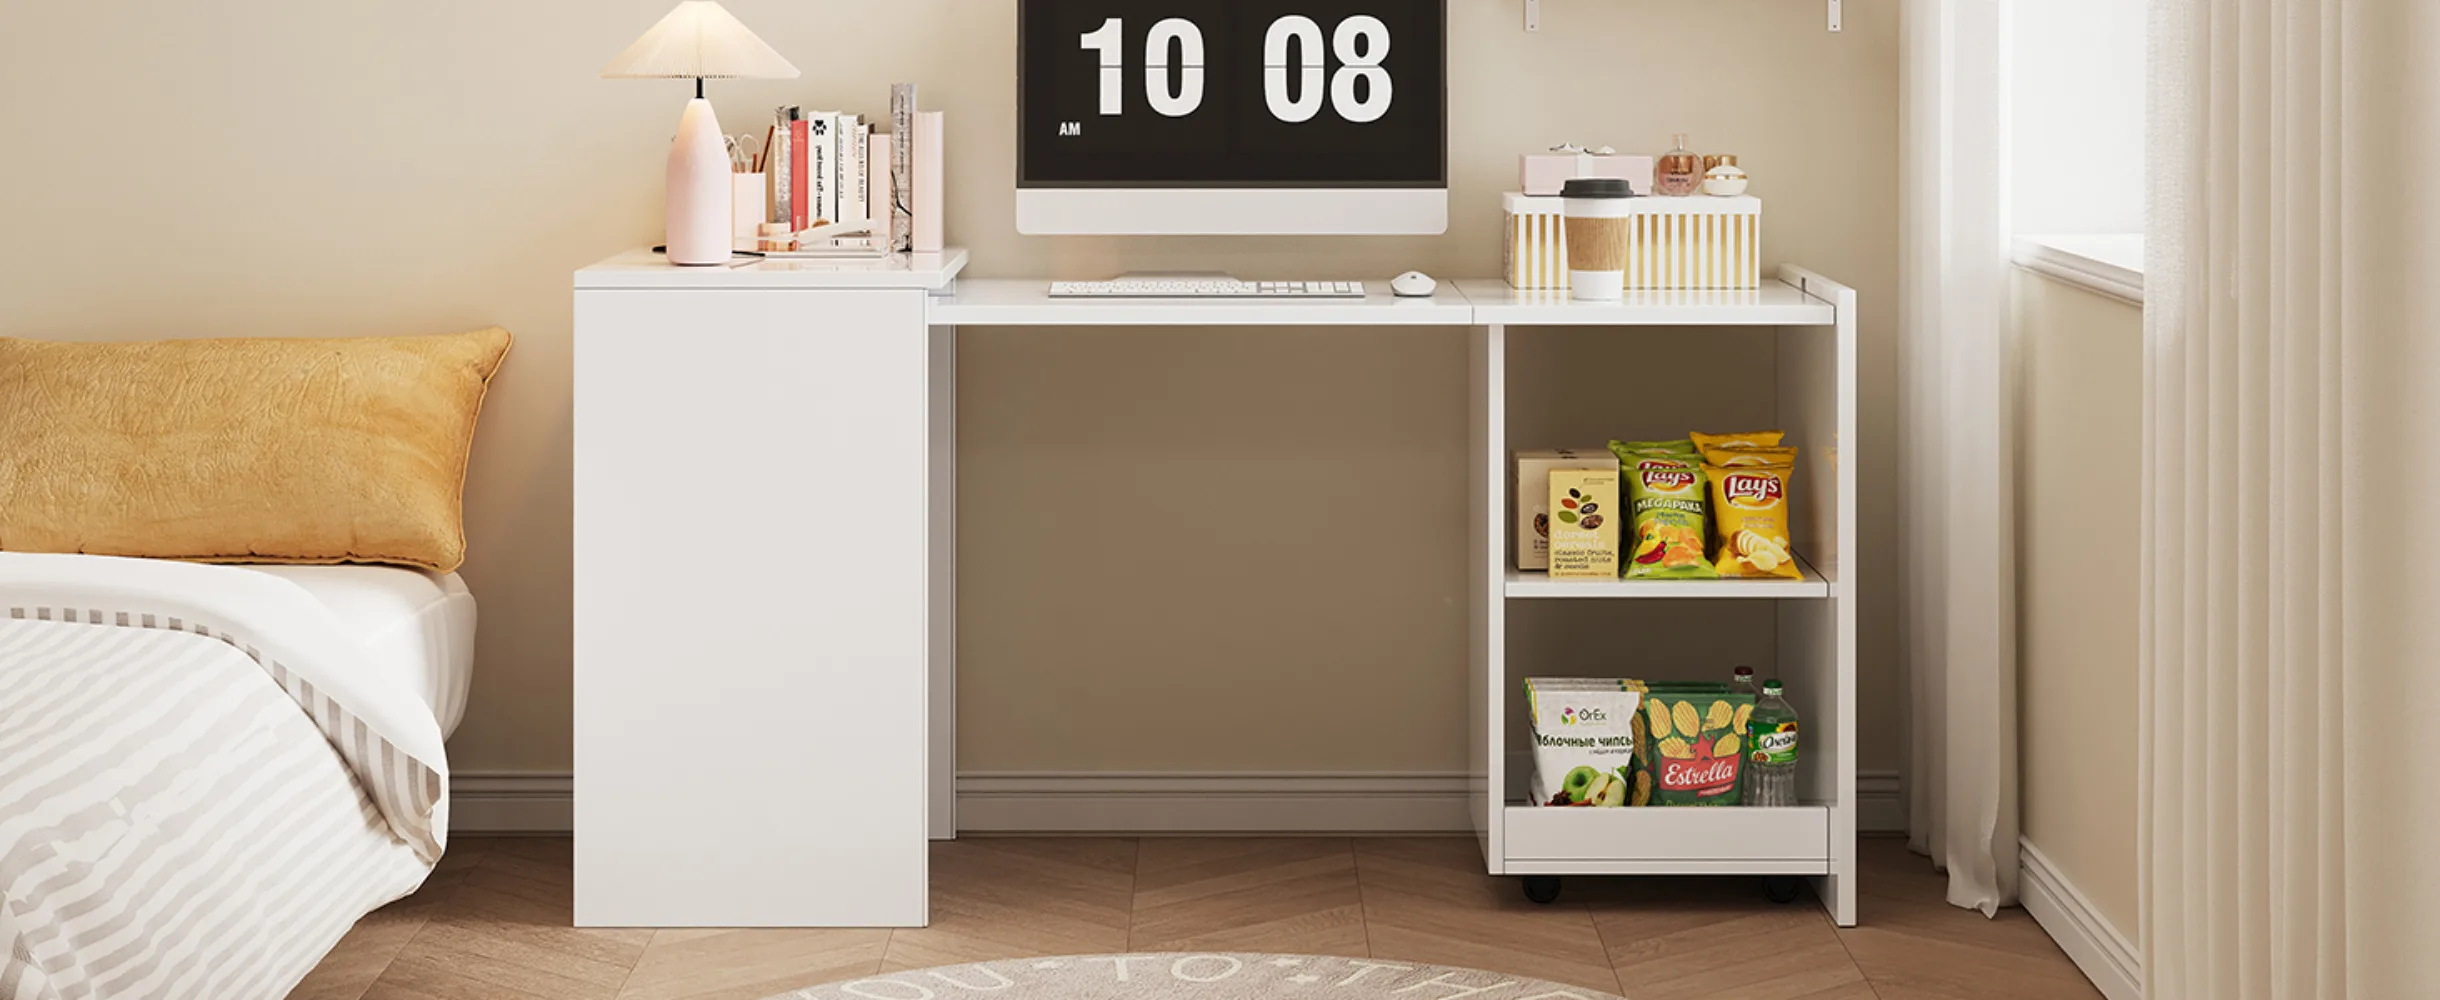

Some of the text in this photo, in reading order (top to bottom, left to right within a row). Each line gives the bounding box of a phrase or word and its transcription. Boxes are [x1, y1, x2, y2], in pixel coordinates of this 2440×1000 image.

[1081, 15, 1393, 122] 10 08
[1059, 122, 1081, 136] AM
[1579, 708, 1607, 721] OrEx
[1664, 760, 1734, 786] Estrella
[797, 955, 1590, 1000] OU TO TH
